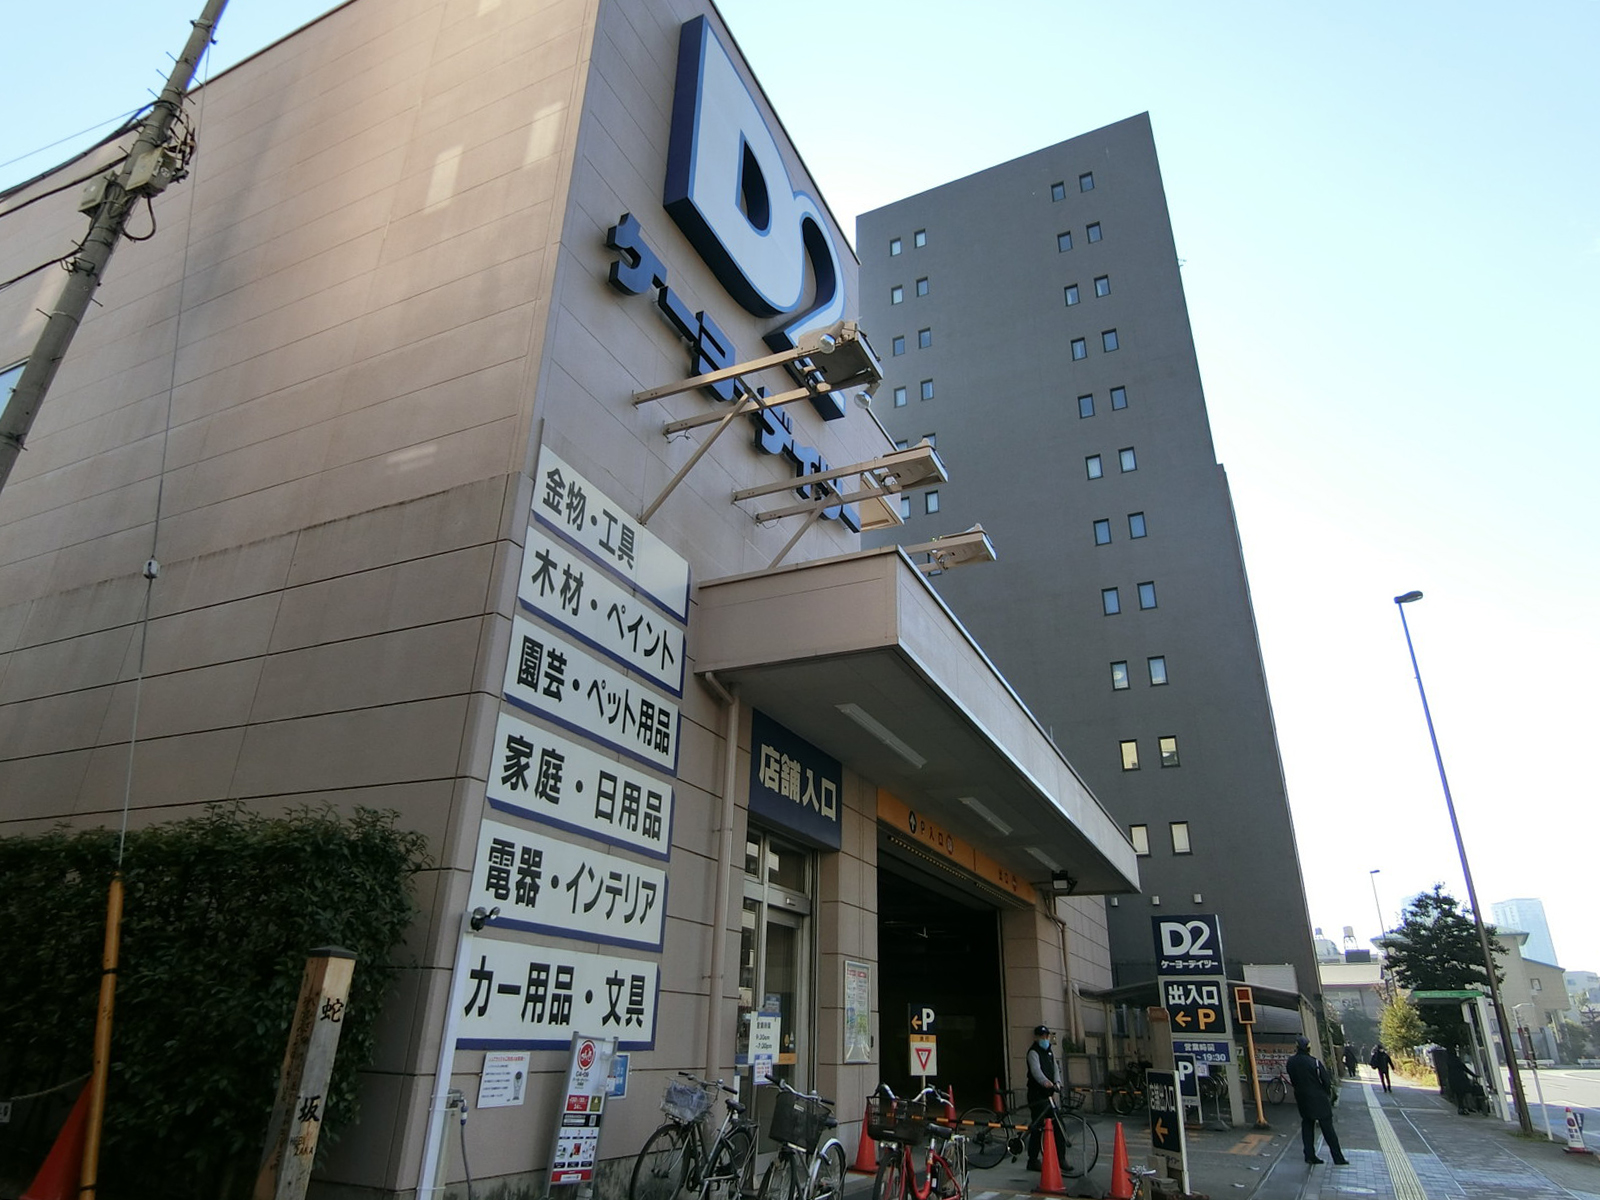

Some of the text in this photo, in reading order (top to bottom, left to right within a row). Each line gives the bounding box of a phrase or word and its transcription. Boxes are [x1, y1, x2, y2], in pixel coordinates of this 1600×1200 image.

[542, 468, 635, 570] 金物・工具
[532, 549, 675, 671] 木材・ペイント
[517, 635, 671, 756] 園芸・ペット用品
[501, 735, 662, 842] 家庭・日用品
[759, 743, 837, 822] 店舗入口
[485, 838, 657, 925] 電器・インテリア
[1160, 921, 1213, 956] D2
[464, 955, 646, 1028] カー用品・文具
[922, 1008, 935, 1031] P
[1168, 985, 1219, 1005] 出入口
[1197, 1008, 1216, 1030] P
[1178, 1061, 1194, 1081] P
